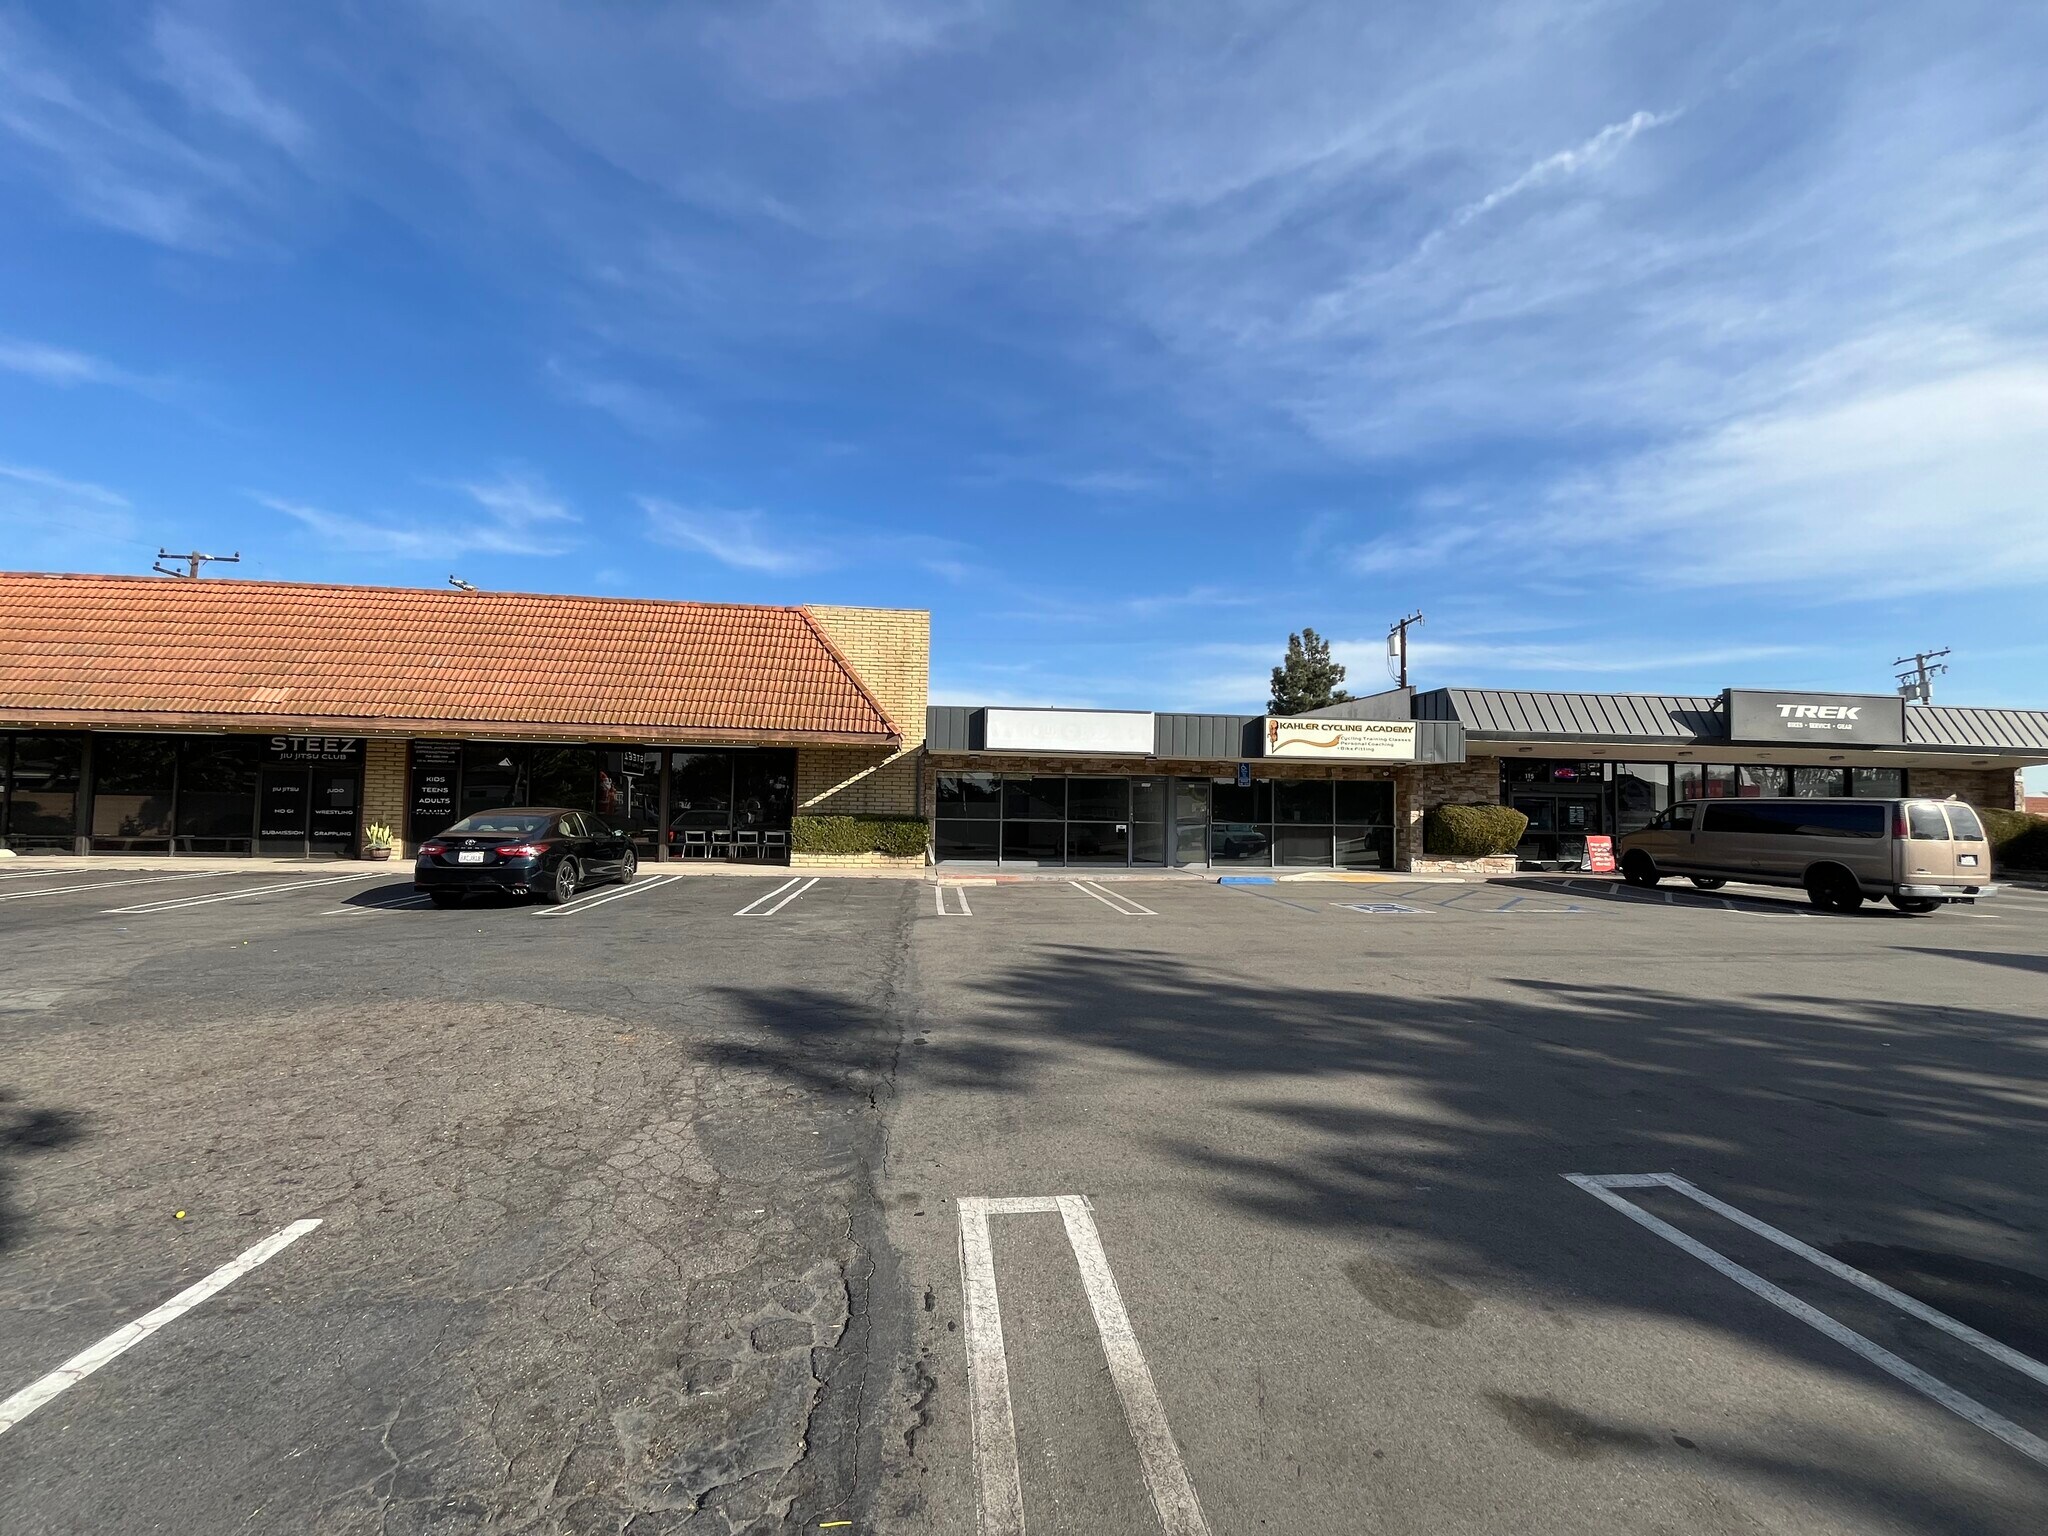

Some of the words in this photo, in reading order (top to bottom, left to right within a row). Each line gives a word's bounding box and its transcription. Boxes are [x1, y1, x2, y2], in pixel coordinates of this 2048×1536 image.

[1776, 704, 1862, 720] TREK
[1280, 722, 1319, 730] KAHLER
[1321, 724, 1362, 732] CYCLING
[271, 737, 356, 752] STEEZ
